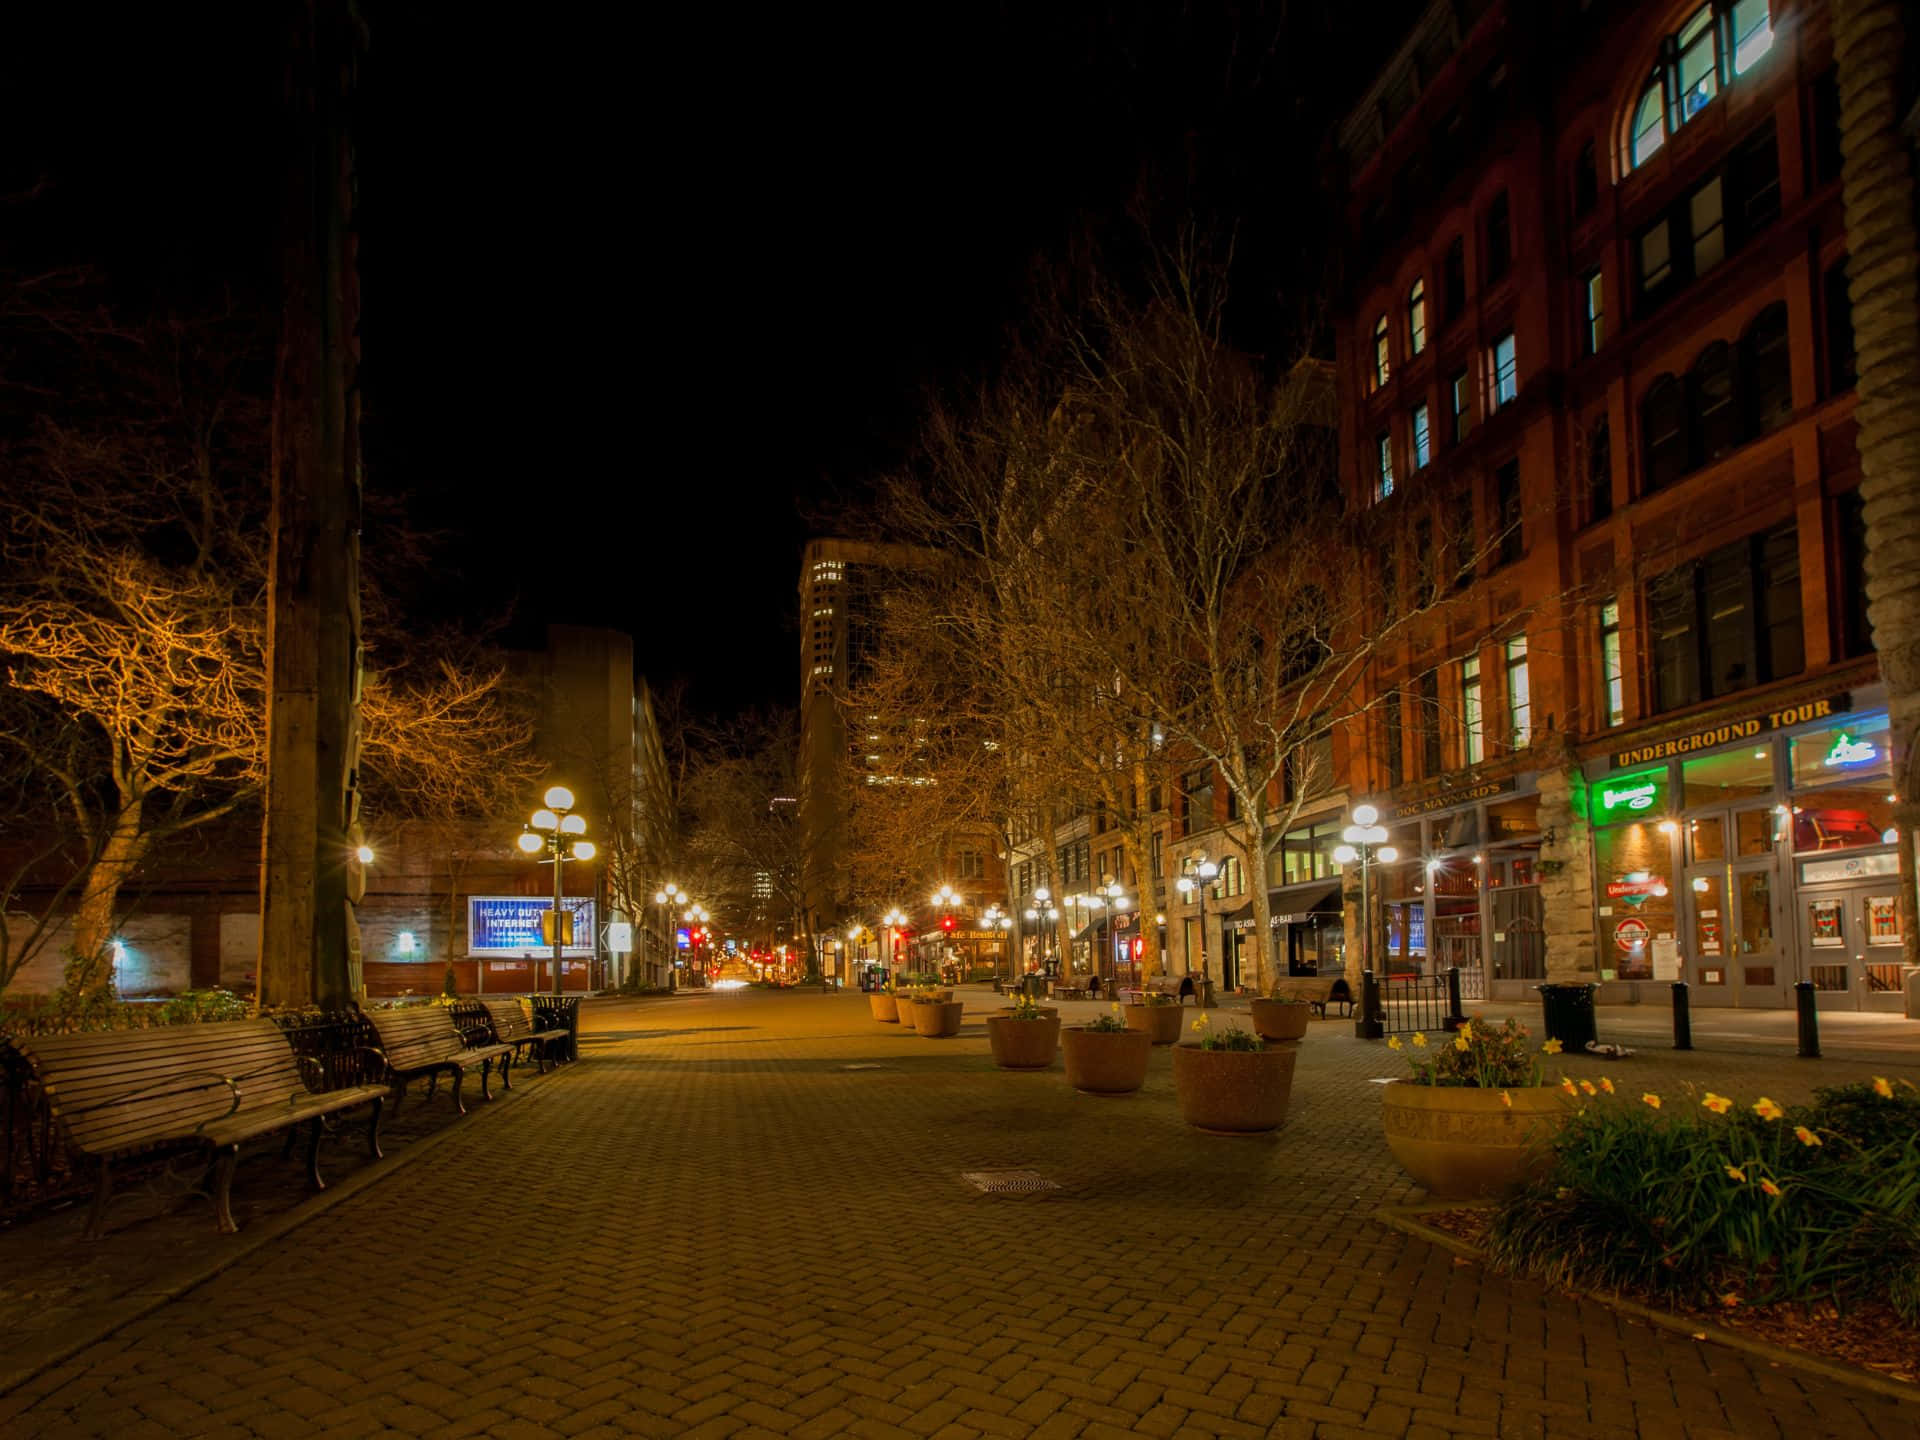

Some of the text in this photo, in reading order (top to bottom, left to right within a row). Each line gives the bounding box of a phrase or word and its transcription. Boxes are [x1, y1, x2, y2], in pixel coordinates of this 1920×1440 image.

[1618, 699, 1833, 767] UNDERGROUND TOUR
[1397, 804, 1418, 817] DOC
[480, 908, 545, 917] HEAVY DUTY
[486, 919, 539, 928] INTERNET
